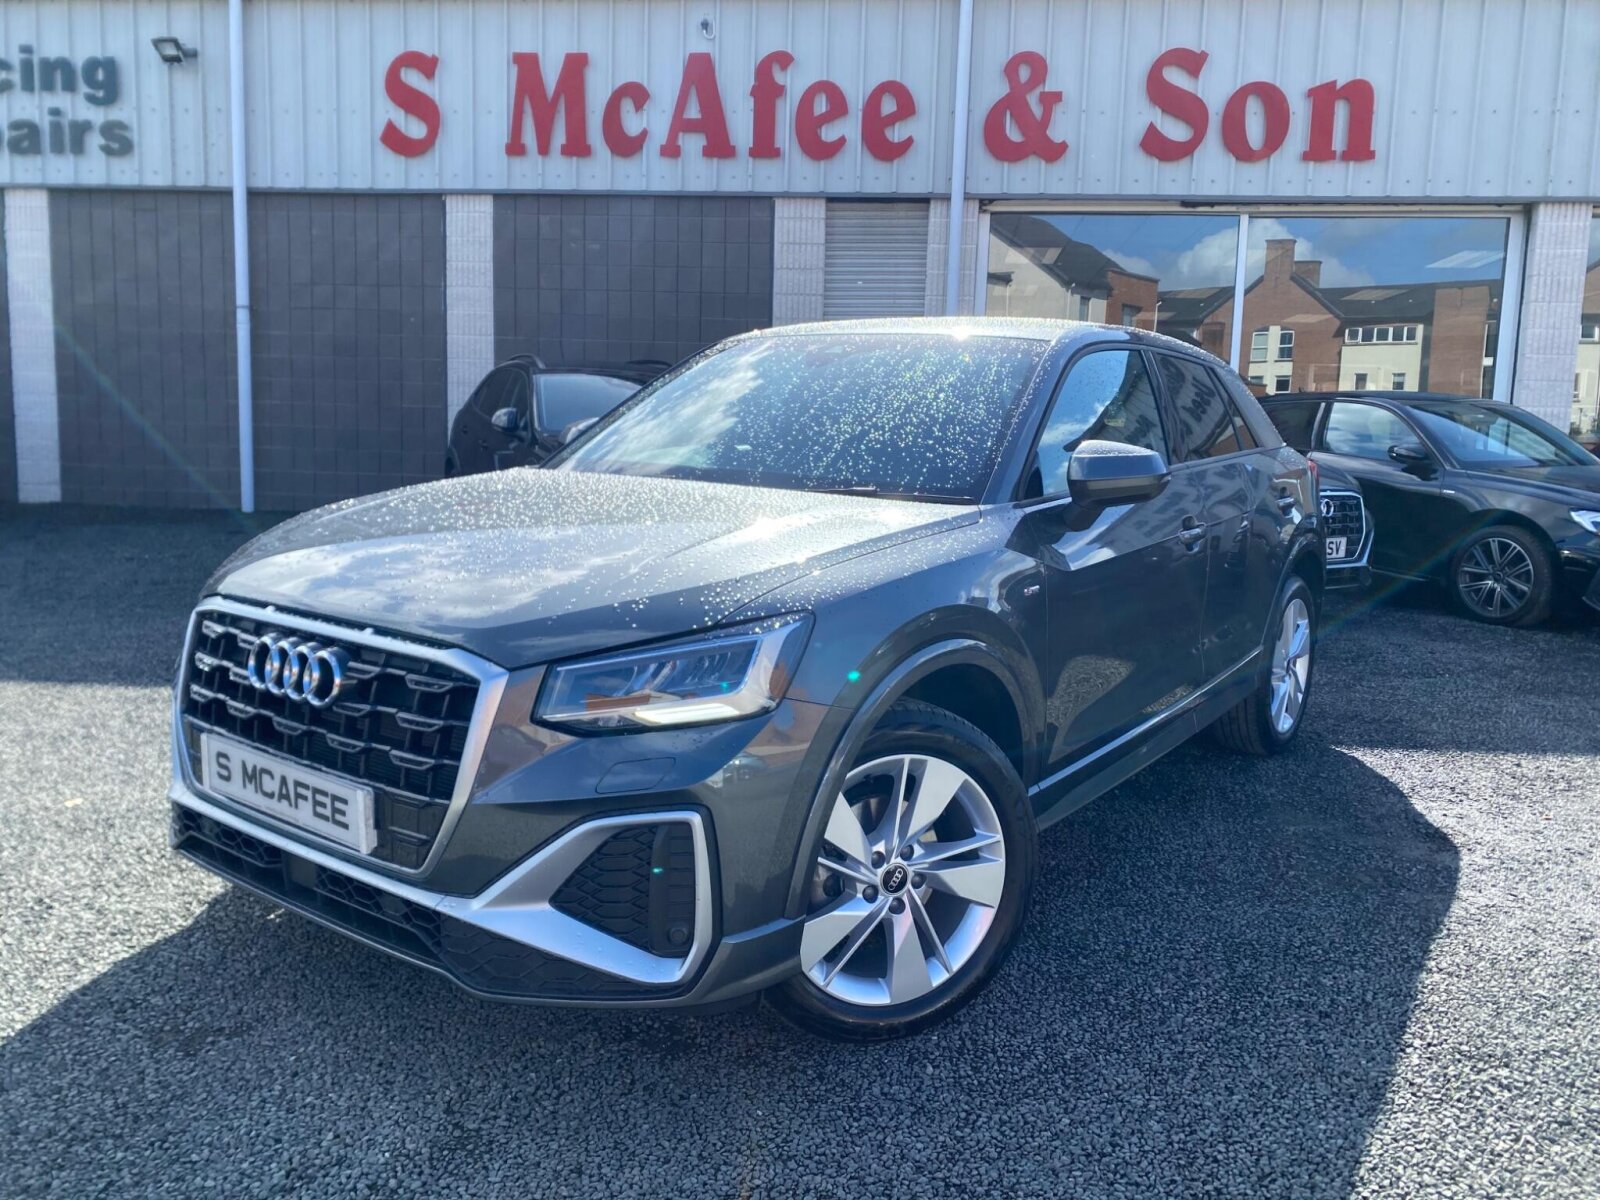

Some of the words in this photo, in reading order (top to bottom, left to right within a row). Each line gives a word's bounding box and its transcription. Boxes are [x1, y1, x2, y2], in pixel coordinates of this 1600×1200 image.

[0, 107, 134, 157] airs
[380, 50, 441, 158] S
[505, 50, 917, 162] McAfee
[983, 50, 1069, 163] &
[1139, 47, 1376, 162] Son
[1327, 540, 1342, 556] SV
[216, 751, 231, 782] S
[241, 760, 349, 830] MCAFEE
